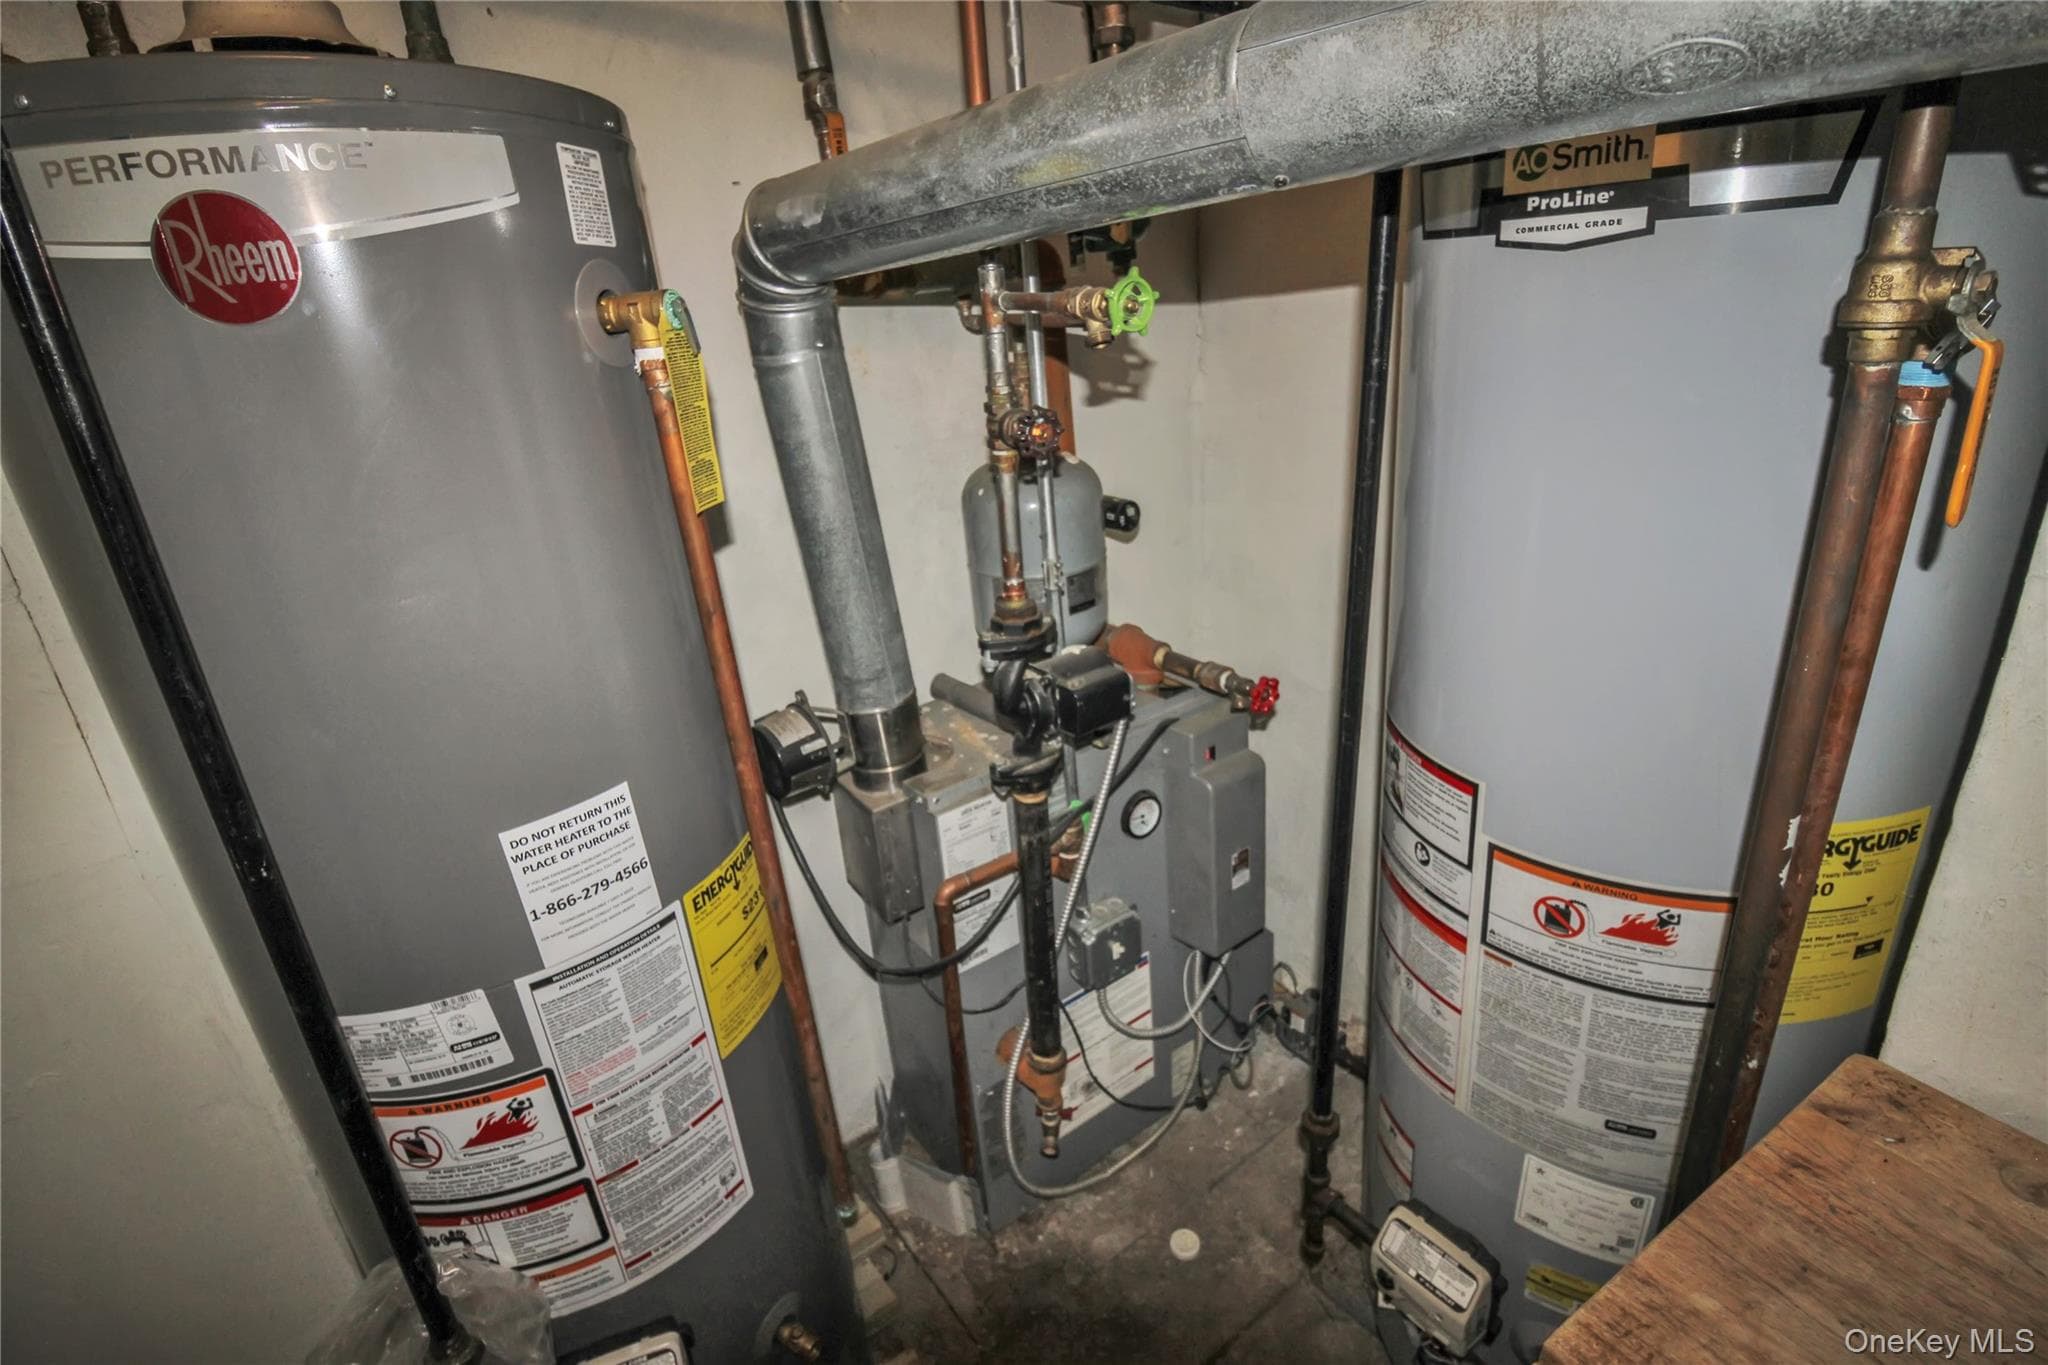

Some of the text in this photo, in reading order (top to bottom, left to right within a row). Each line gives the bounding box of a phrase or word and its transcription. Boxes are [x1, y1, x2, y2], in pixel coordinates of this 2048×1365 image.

[39, 141, 369, 189] PERFORMANCE
[1552, 134, 1644, 171] Smith
[1527, 190, 1611, 212] ProLine
[1516, 218, 1623, 234] COMMERCIAL GRADE
[157, 193, 297, 304] Rheem
[509, 794, 626, 850] DO NOT RETURN THIS
[510, 805, 633, 864] WATER HEATER TO THE
[522, 821, 631, 875] PLACE OF PURCHASE
[530, 857, 649, 922] 1-866-279-4566
[1582, 882, 1639, 902] WARNING
[552, 960, 595, 982] INSTALLATION
[596, 952, 610, 963] AND
[559, 972, 594, 990] AUTOMATIC
[422, 1095, 493, 1114] WARNING
[473, 1206, 528, 1224] DANGER
